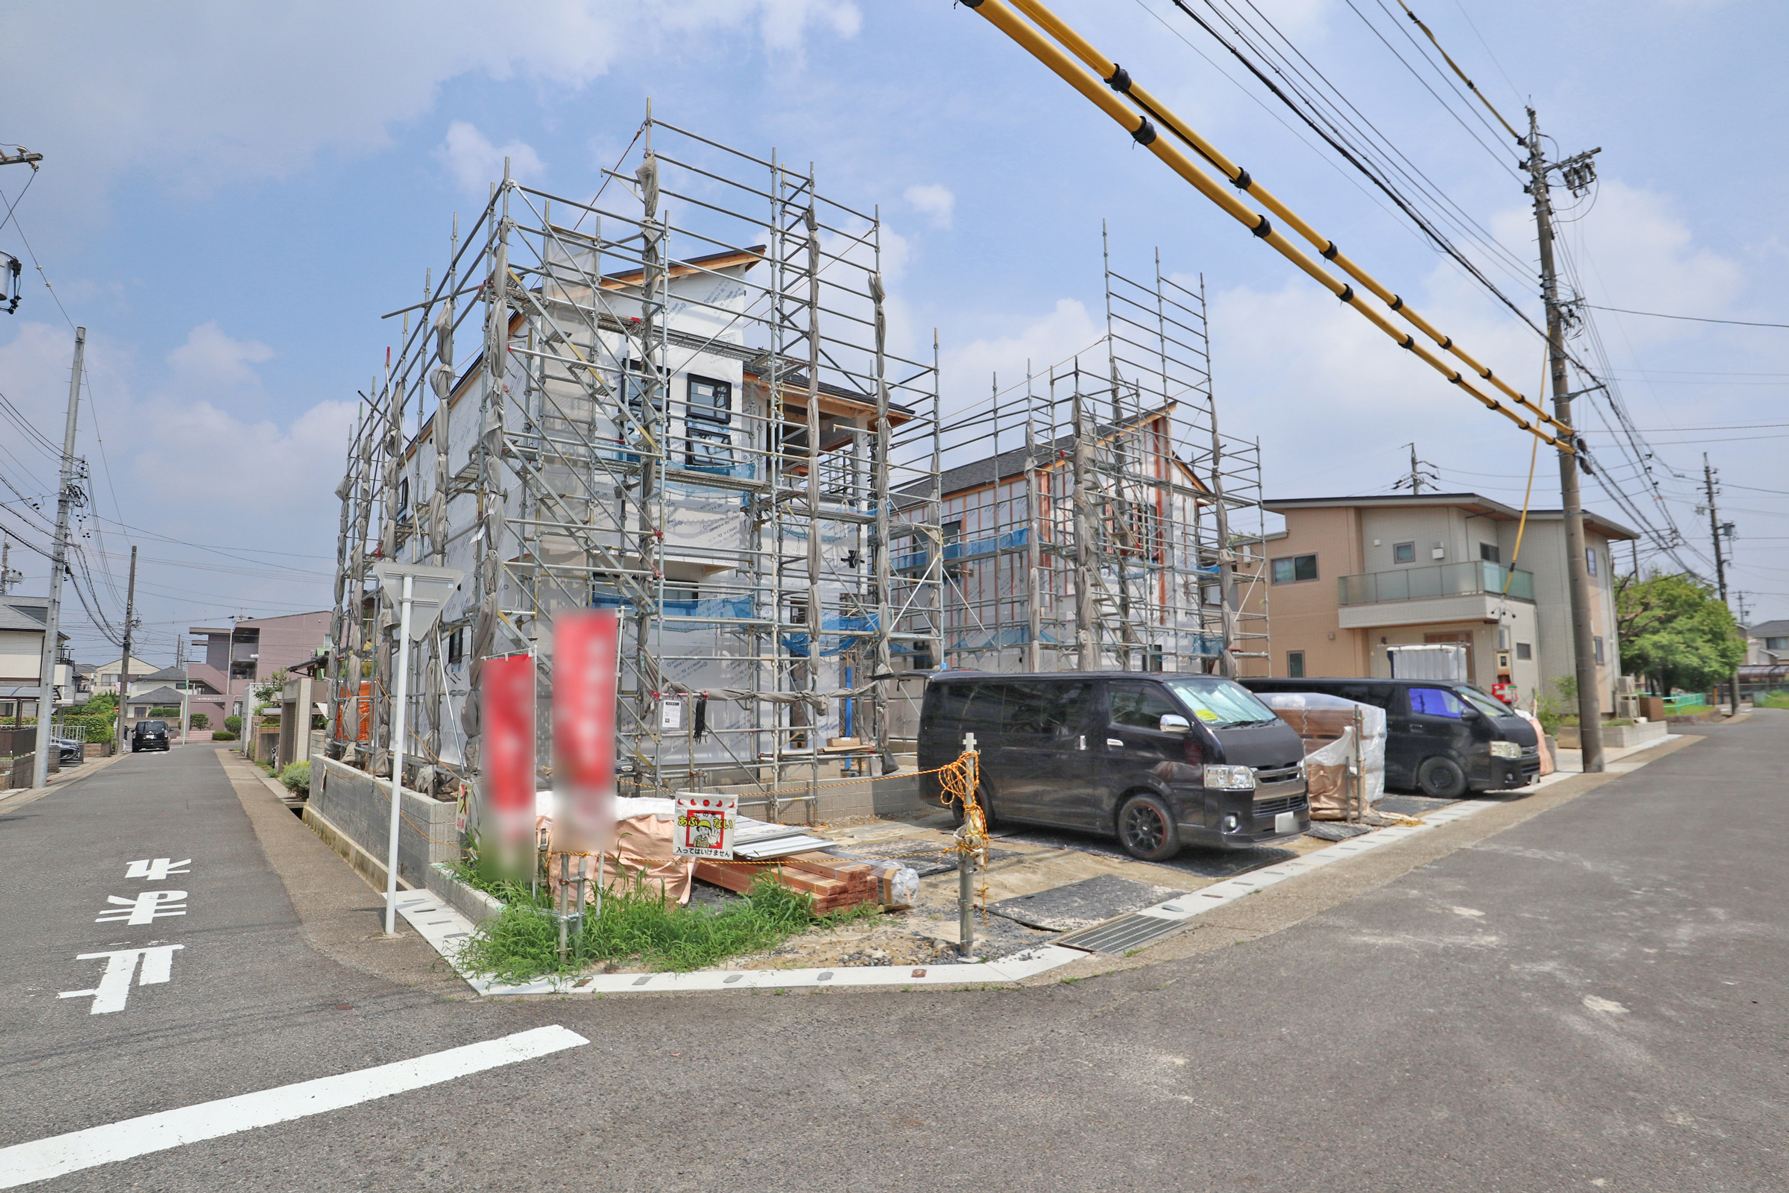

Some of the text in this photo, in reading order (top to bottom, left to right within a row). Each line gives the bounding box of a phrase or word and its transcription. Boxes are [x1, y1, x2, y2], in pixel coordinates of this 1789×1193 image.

[676, 847, 730, 858] 入ってはいけません
